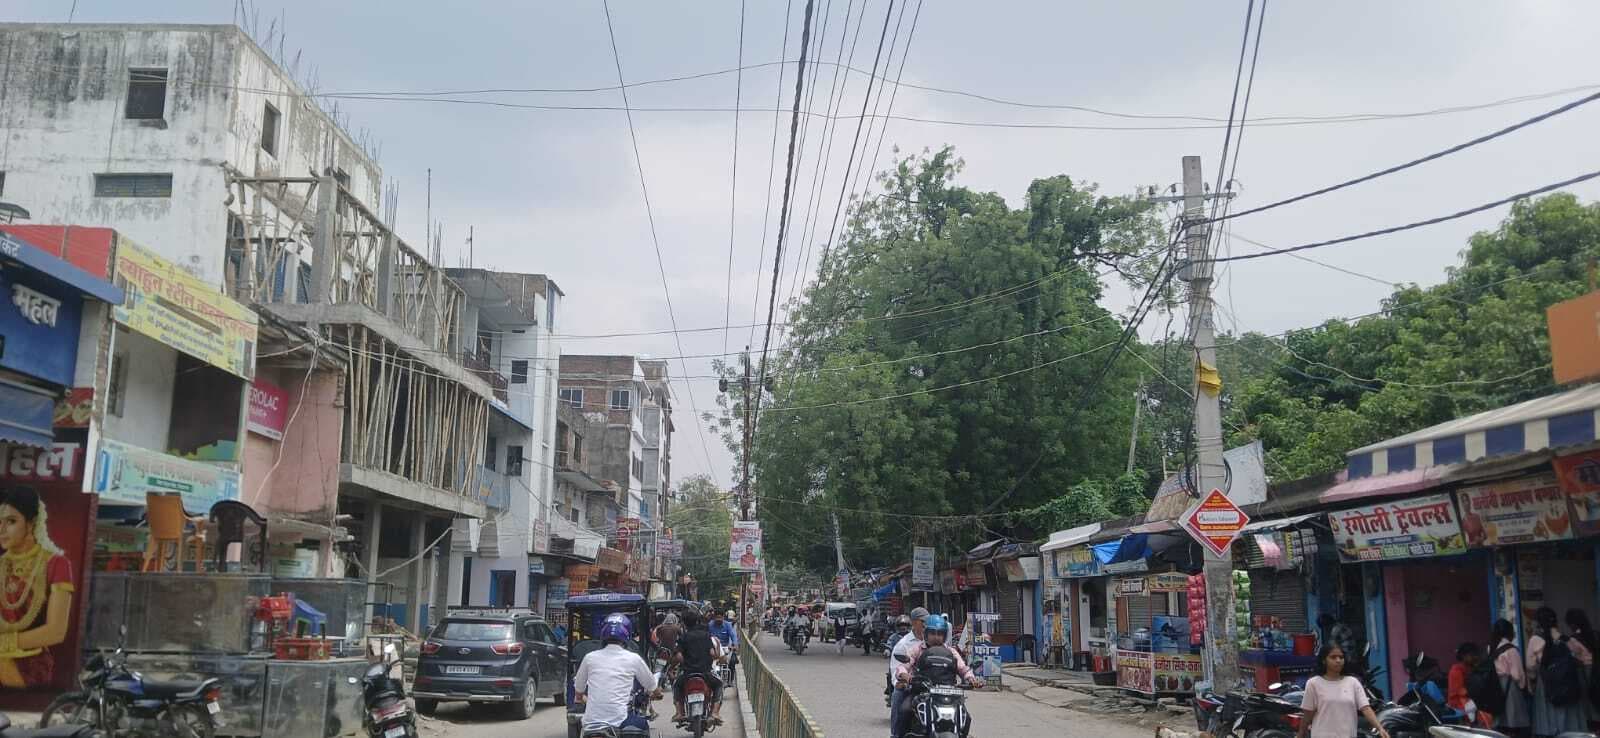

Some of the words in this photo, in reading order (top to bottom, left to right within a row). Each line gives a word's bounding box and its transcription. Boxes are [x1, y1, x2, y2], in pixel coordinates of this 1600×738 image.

[11, 283, 62, 328] महल
[1341, 504, 1394, 536] रंगोली
[1391, 501, 1453, 535] ट्रेवल्स
[974, 643, 1001, 656] फोन
